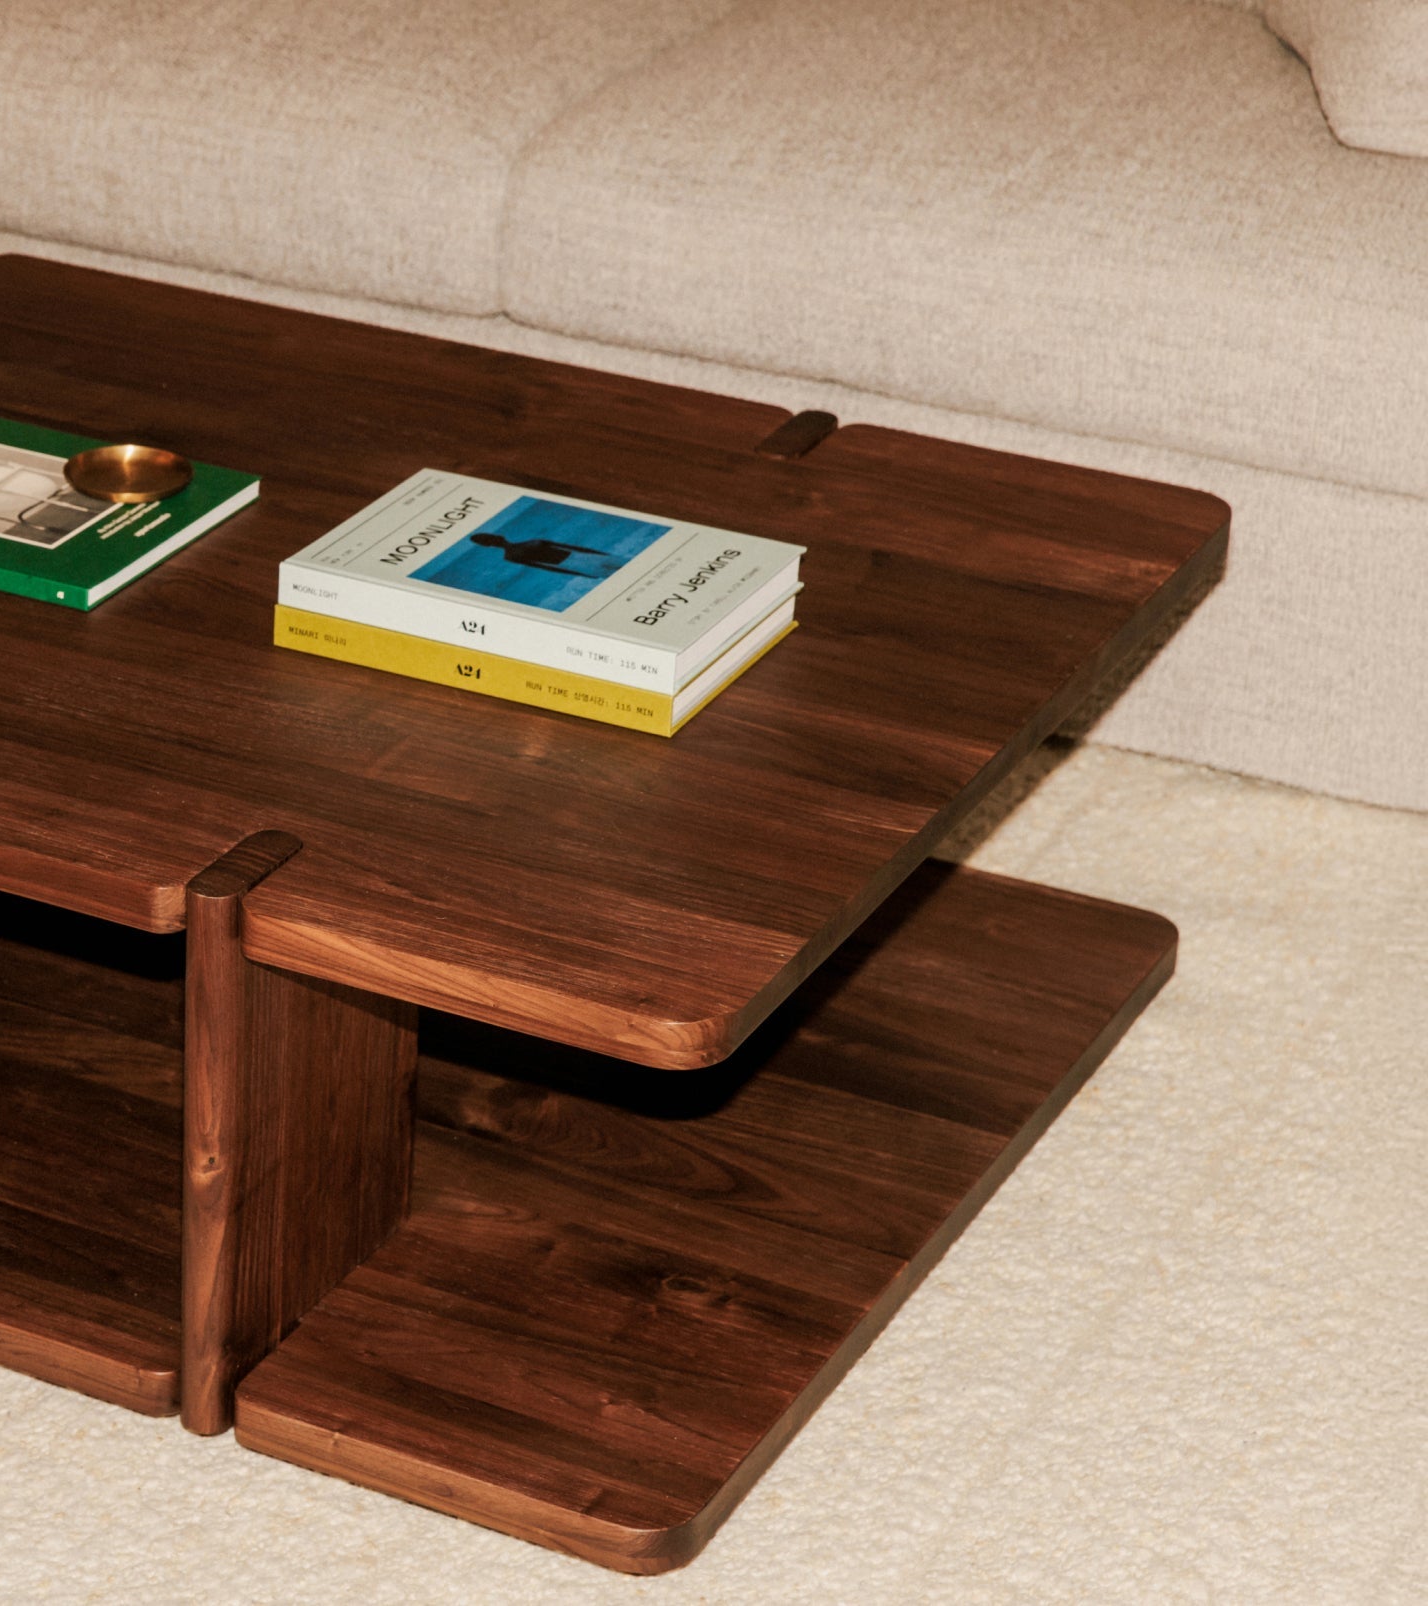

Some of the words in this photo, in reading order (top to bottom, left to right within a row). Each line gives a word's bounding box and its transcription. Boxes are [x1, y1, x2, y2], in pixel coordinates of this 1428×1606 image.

[380, 496, 485, 566] MOONLIGHT
[292, 583, 338, 601] MOONLIGHT
[633, 592, 689, 626] Barry
[679, 548, 742, 593] Jenkins
[288, 626, 319, 640] MINARI
[458, 620, 486, 636] A24
[454, 663, 481, 680] A24
[566, 646, 583, 658] RUN
[641, 664, 658, 675] MIN
[525, 680, 542, 692] RUN
[547, 685, 568, 698] TIME
[636, 707, 654, 717] MIN
